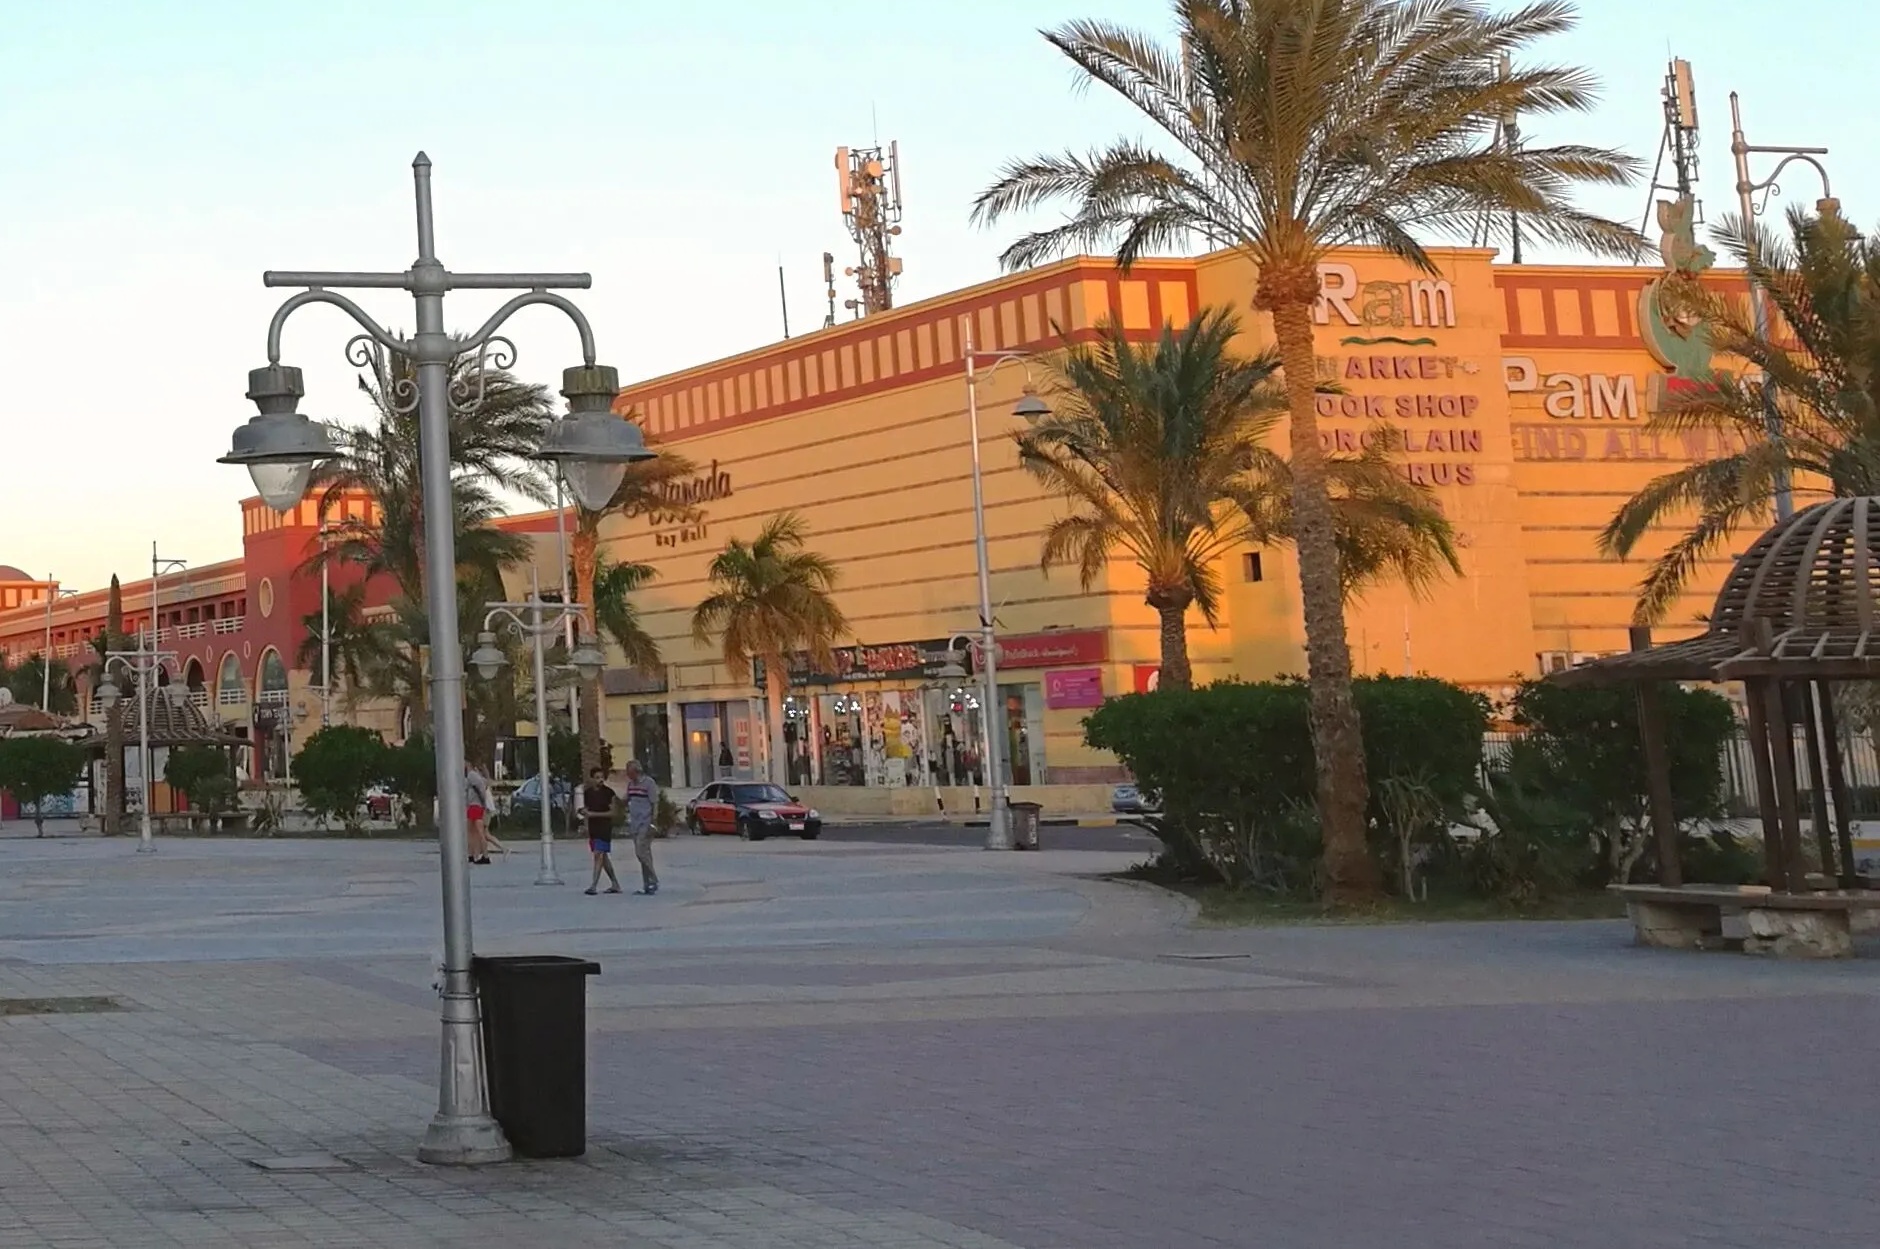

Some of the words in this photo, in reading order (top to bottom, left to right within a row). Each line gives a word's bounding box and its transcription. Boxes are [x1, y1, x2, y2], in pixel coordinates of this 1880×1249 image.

[1314, 262, 1457, 328] Ram
[1316, 394, 1386, 418] OOK
[1394, 394, 1480, 418] SHOP
[1511, 426, 1587, 461] IND
[1604, 428, 1667, 461] ALL
